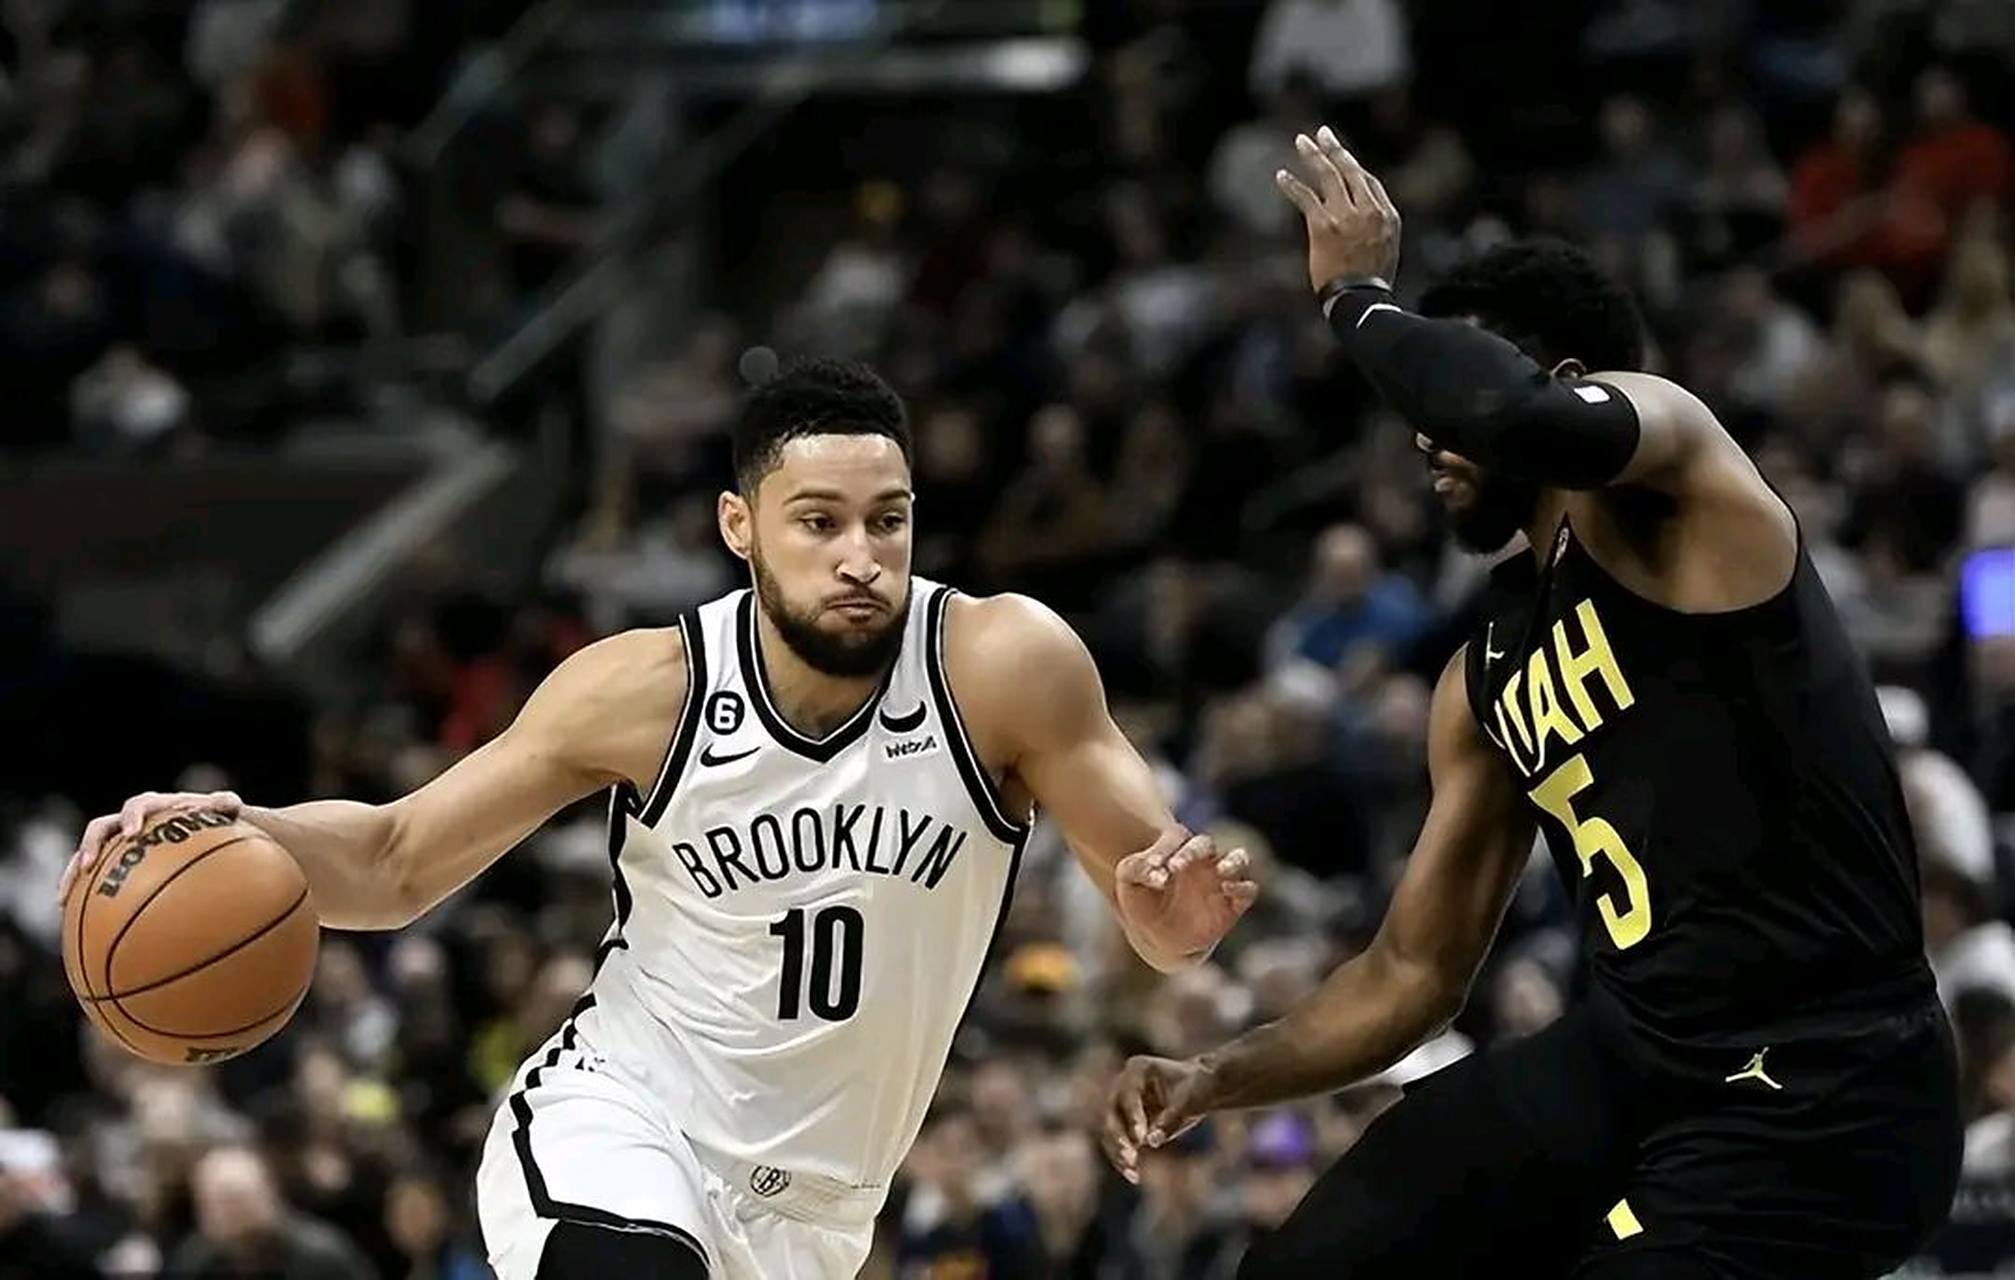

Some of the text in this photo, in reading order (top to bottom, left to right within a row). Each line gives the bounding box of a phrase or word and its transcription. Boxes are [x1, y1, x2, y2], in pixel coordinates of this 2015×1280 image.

[713, 696, 737, 730] 6
[672, 803, 967, 898] BROOKLYN
[1528, 752, 1651, 950] 5
[769, 905, 864, 1022] 10
